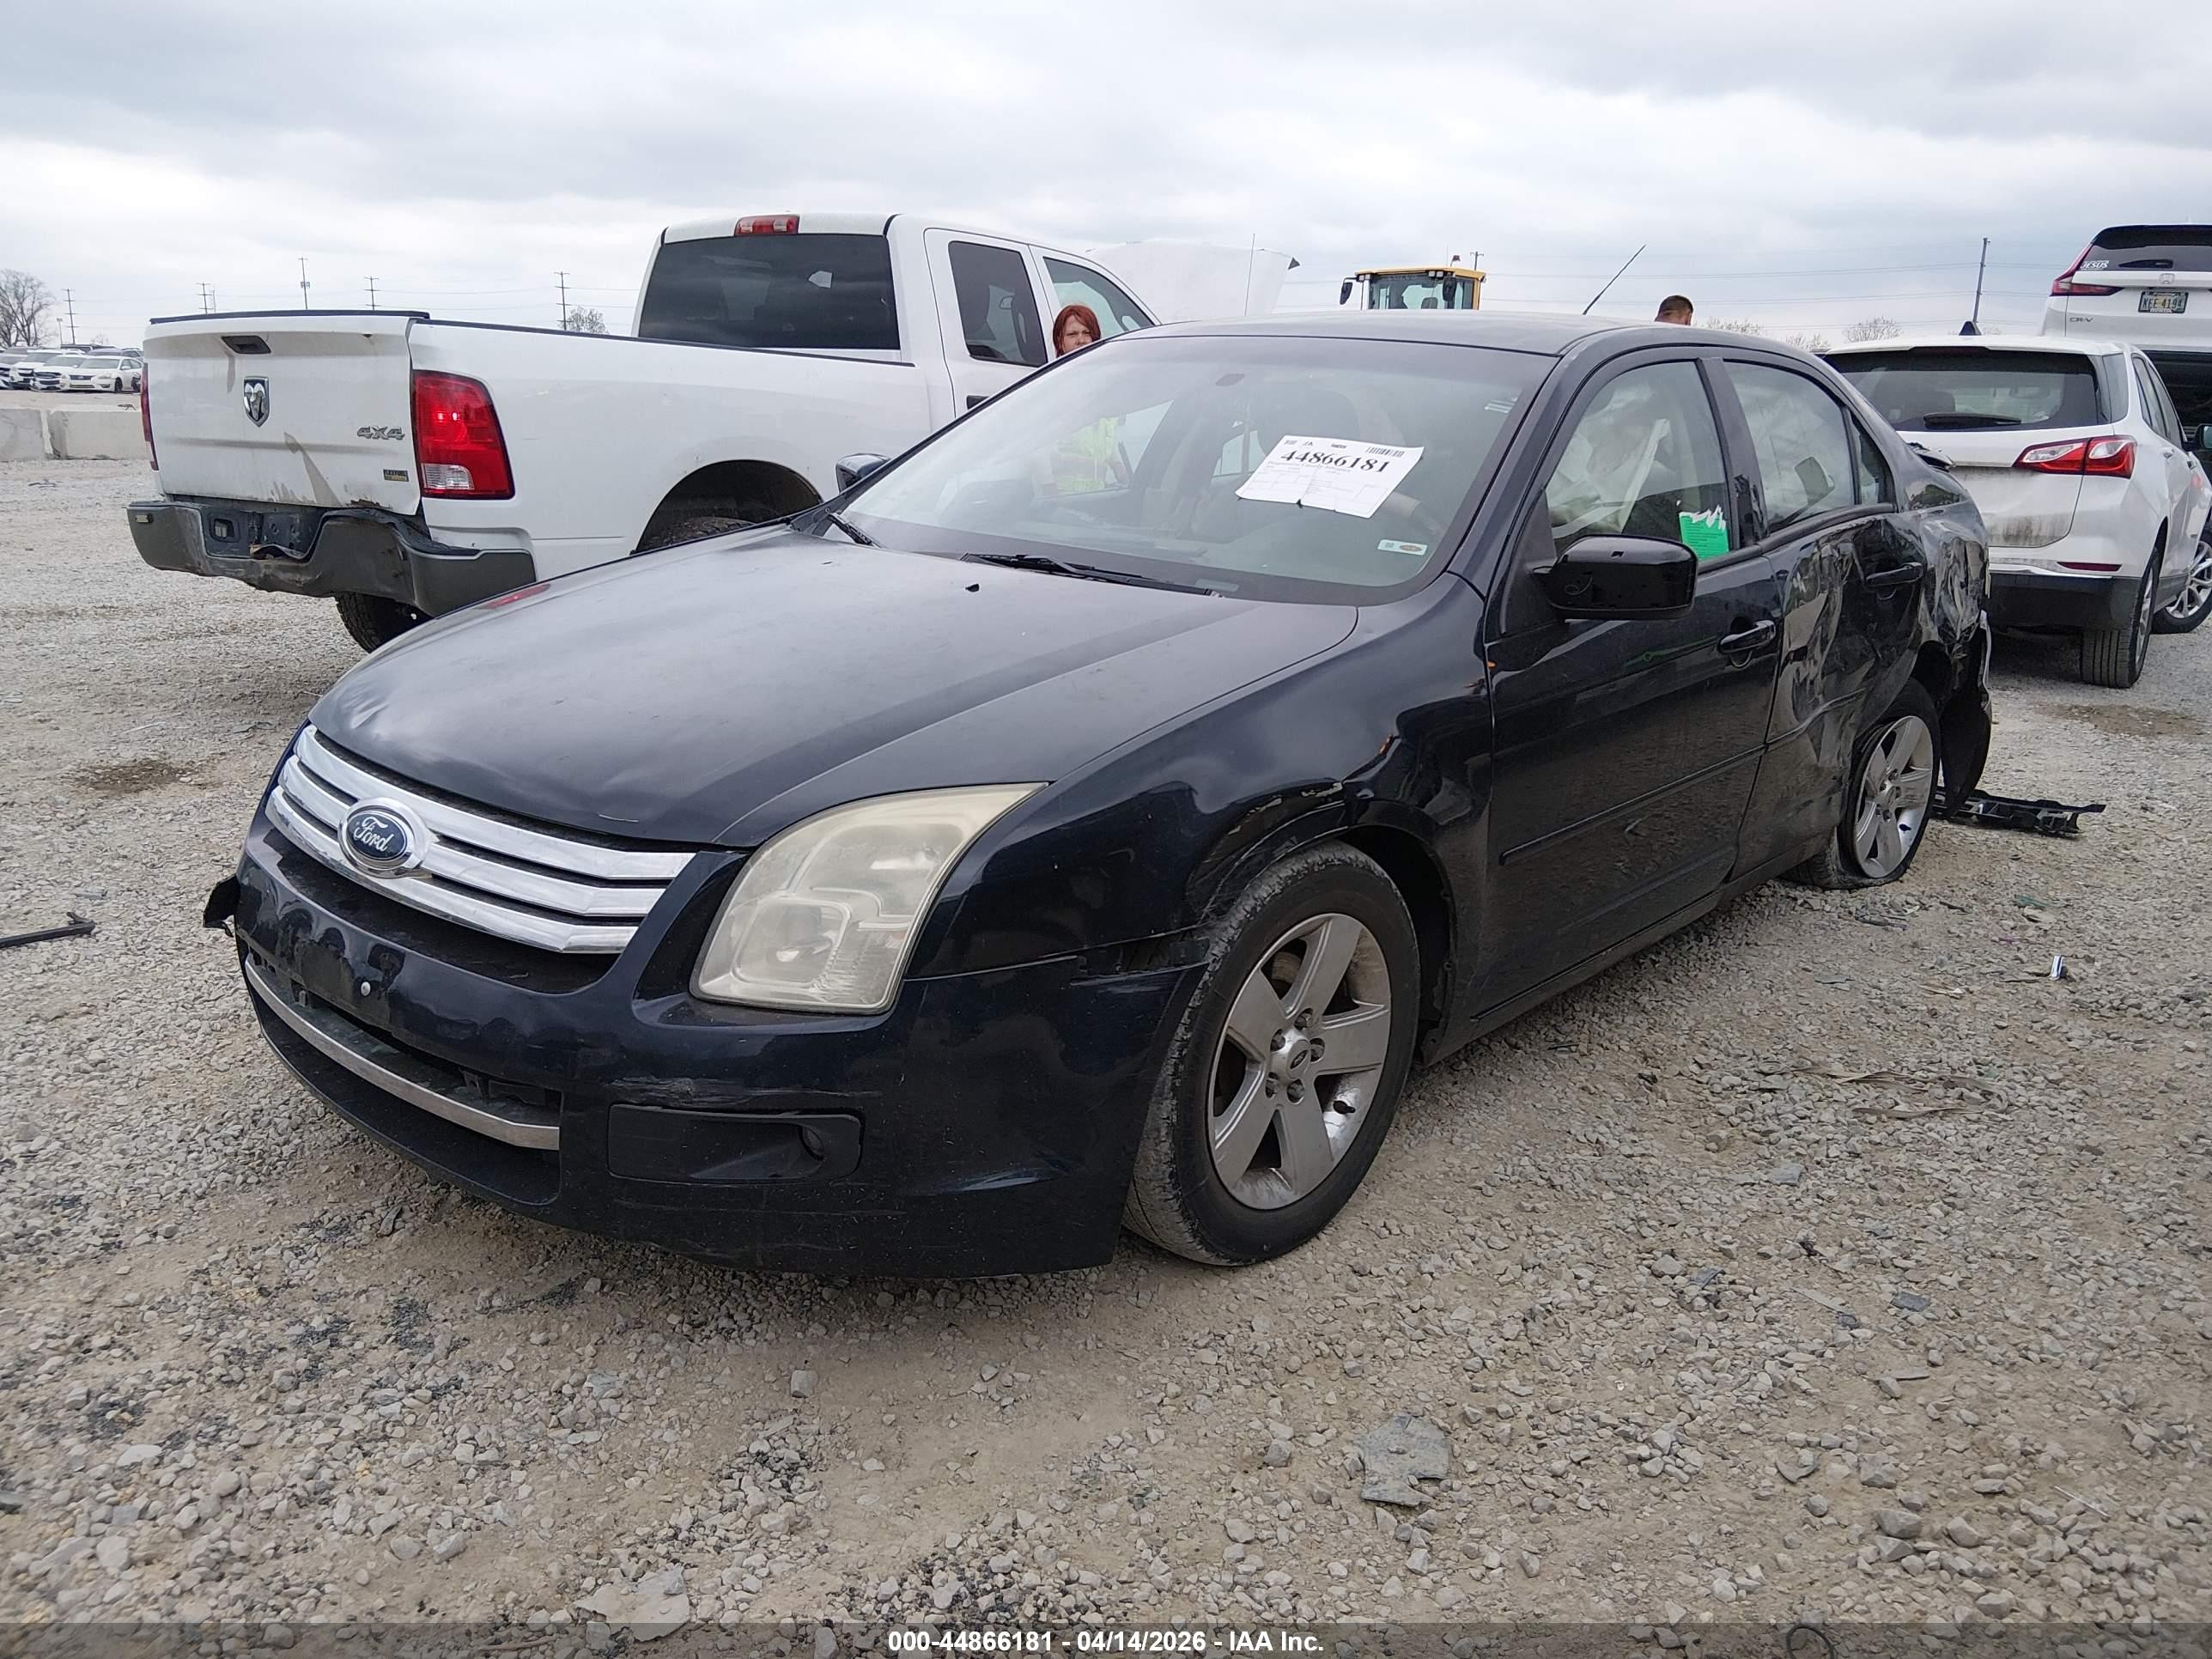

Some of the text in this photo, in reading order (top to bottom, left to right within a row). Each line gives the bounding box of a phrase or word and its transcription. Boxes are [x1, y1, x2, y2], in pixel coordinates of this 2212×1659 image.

[2080, 259, 2110, 269] JESUS
[1280, 450, 1391, 473] 44866181
[353, 816, 394, 852] Ford
